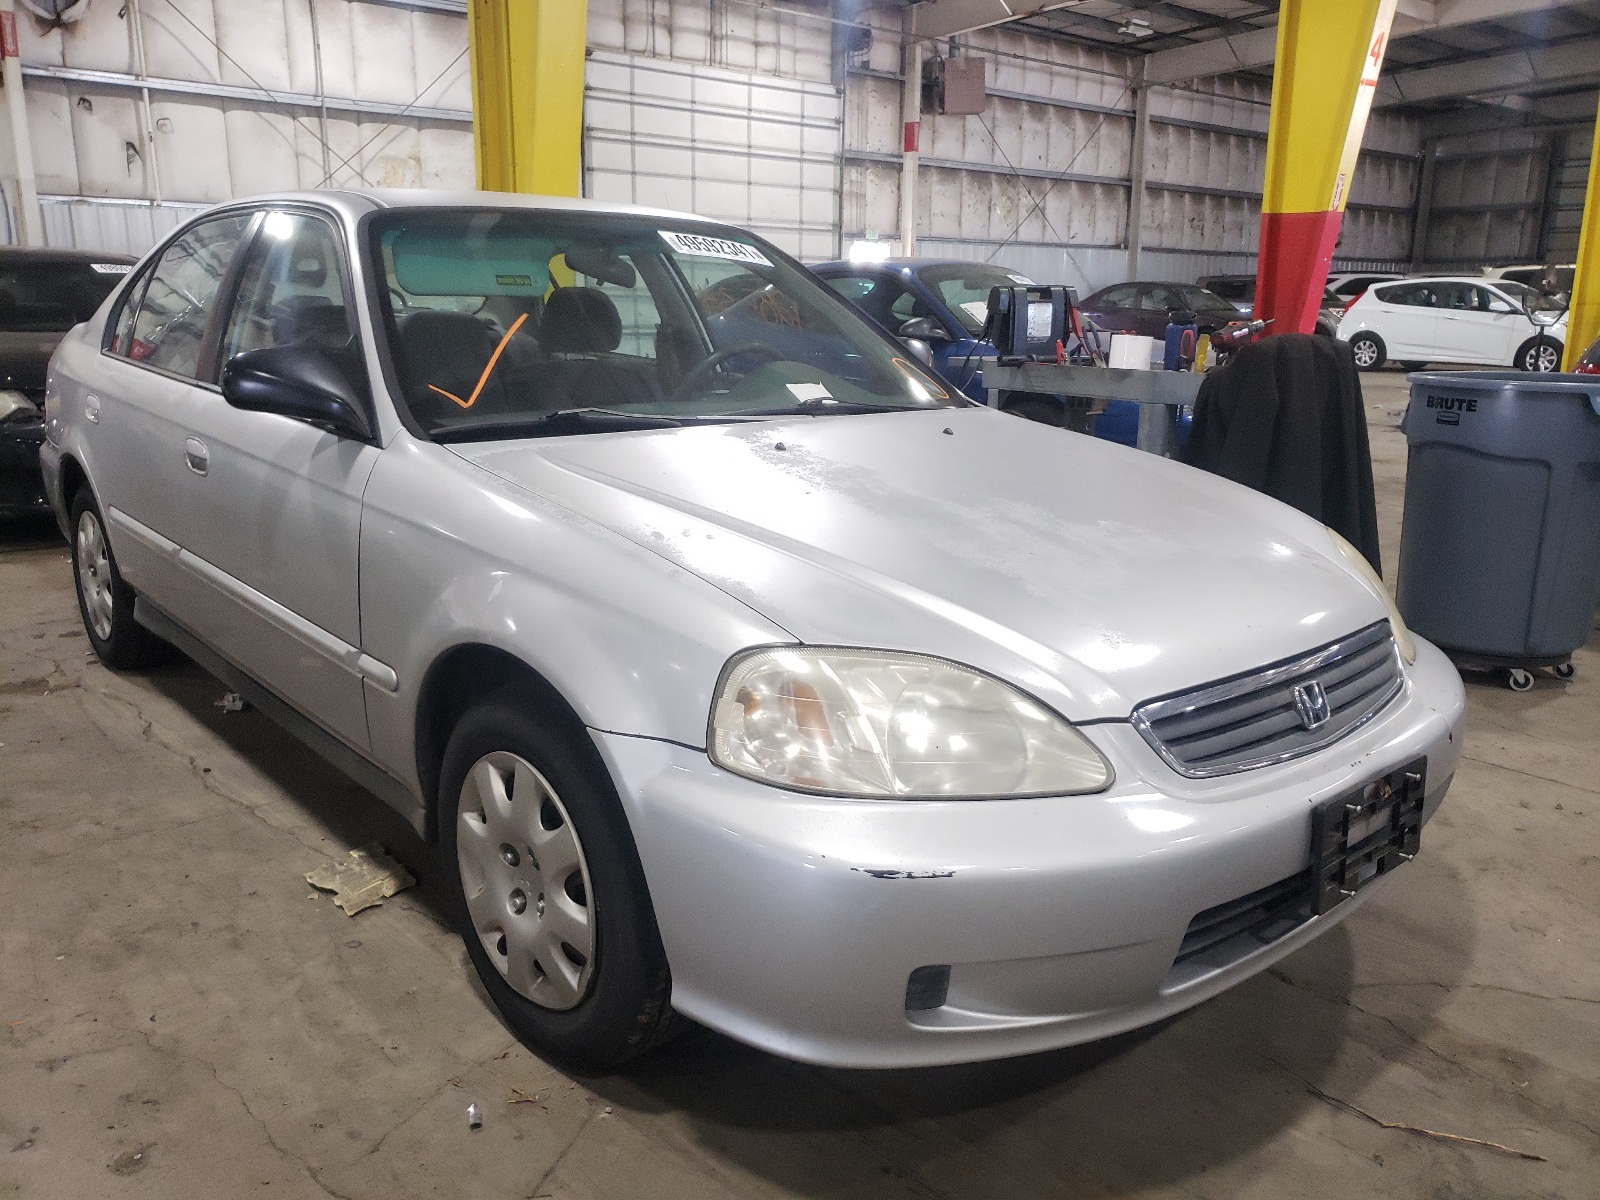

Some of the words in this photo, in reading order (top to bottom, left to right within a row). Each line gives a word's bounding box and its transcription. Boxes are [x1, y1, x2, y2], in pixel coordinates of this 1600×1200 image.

[1370, 31, 1385, 67] 4
[675, 234, 756, 260] 49592341
[1426, 395, 1478, 413] BRUTE
